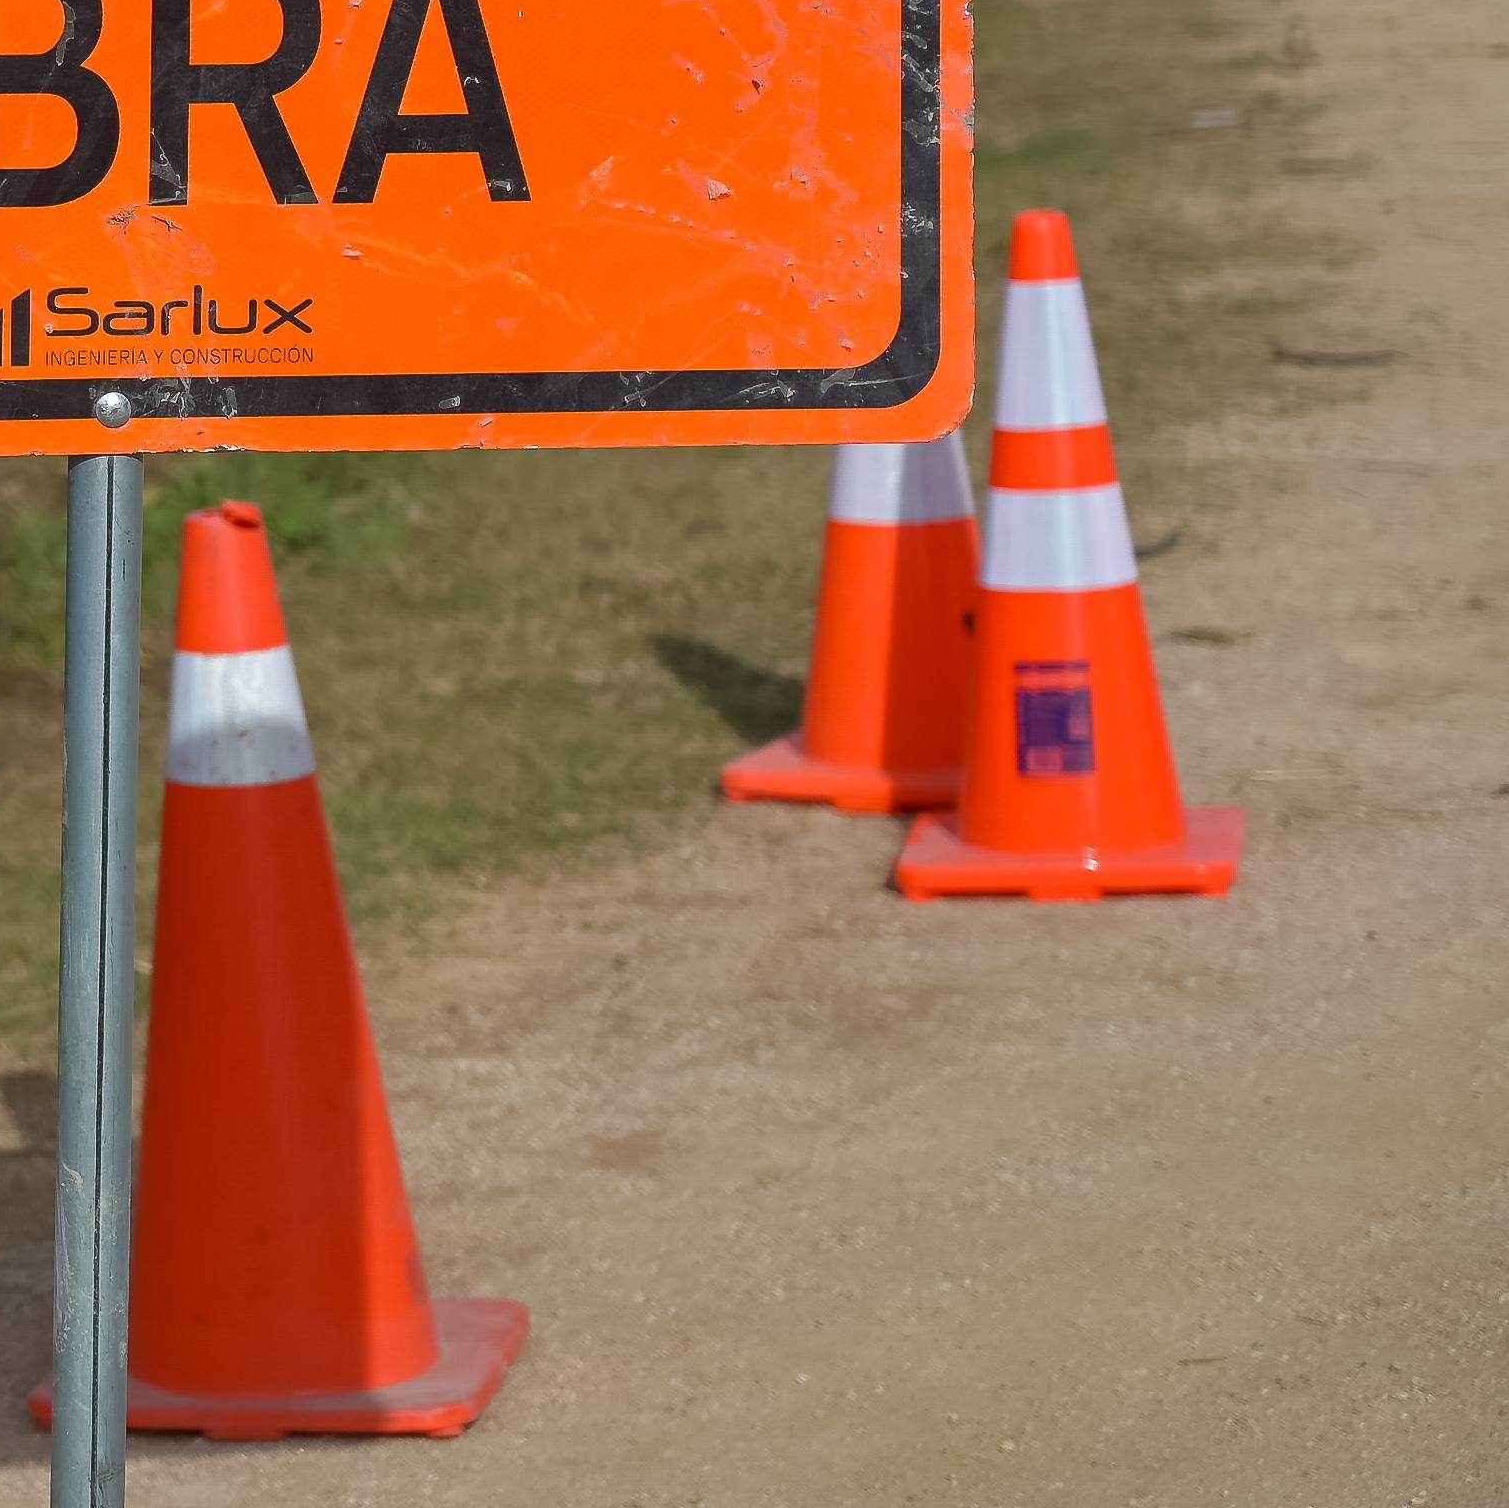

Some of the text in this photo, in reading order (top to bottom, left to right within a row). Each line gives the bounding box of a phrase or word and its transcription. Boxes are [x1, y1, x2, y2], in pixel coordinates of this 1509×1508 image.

[46, 284, 313, 336] Sarlux
[45, 343, 314, 367] INGENIERÍA Y CONSTRUCCIÓN
